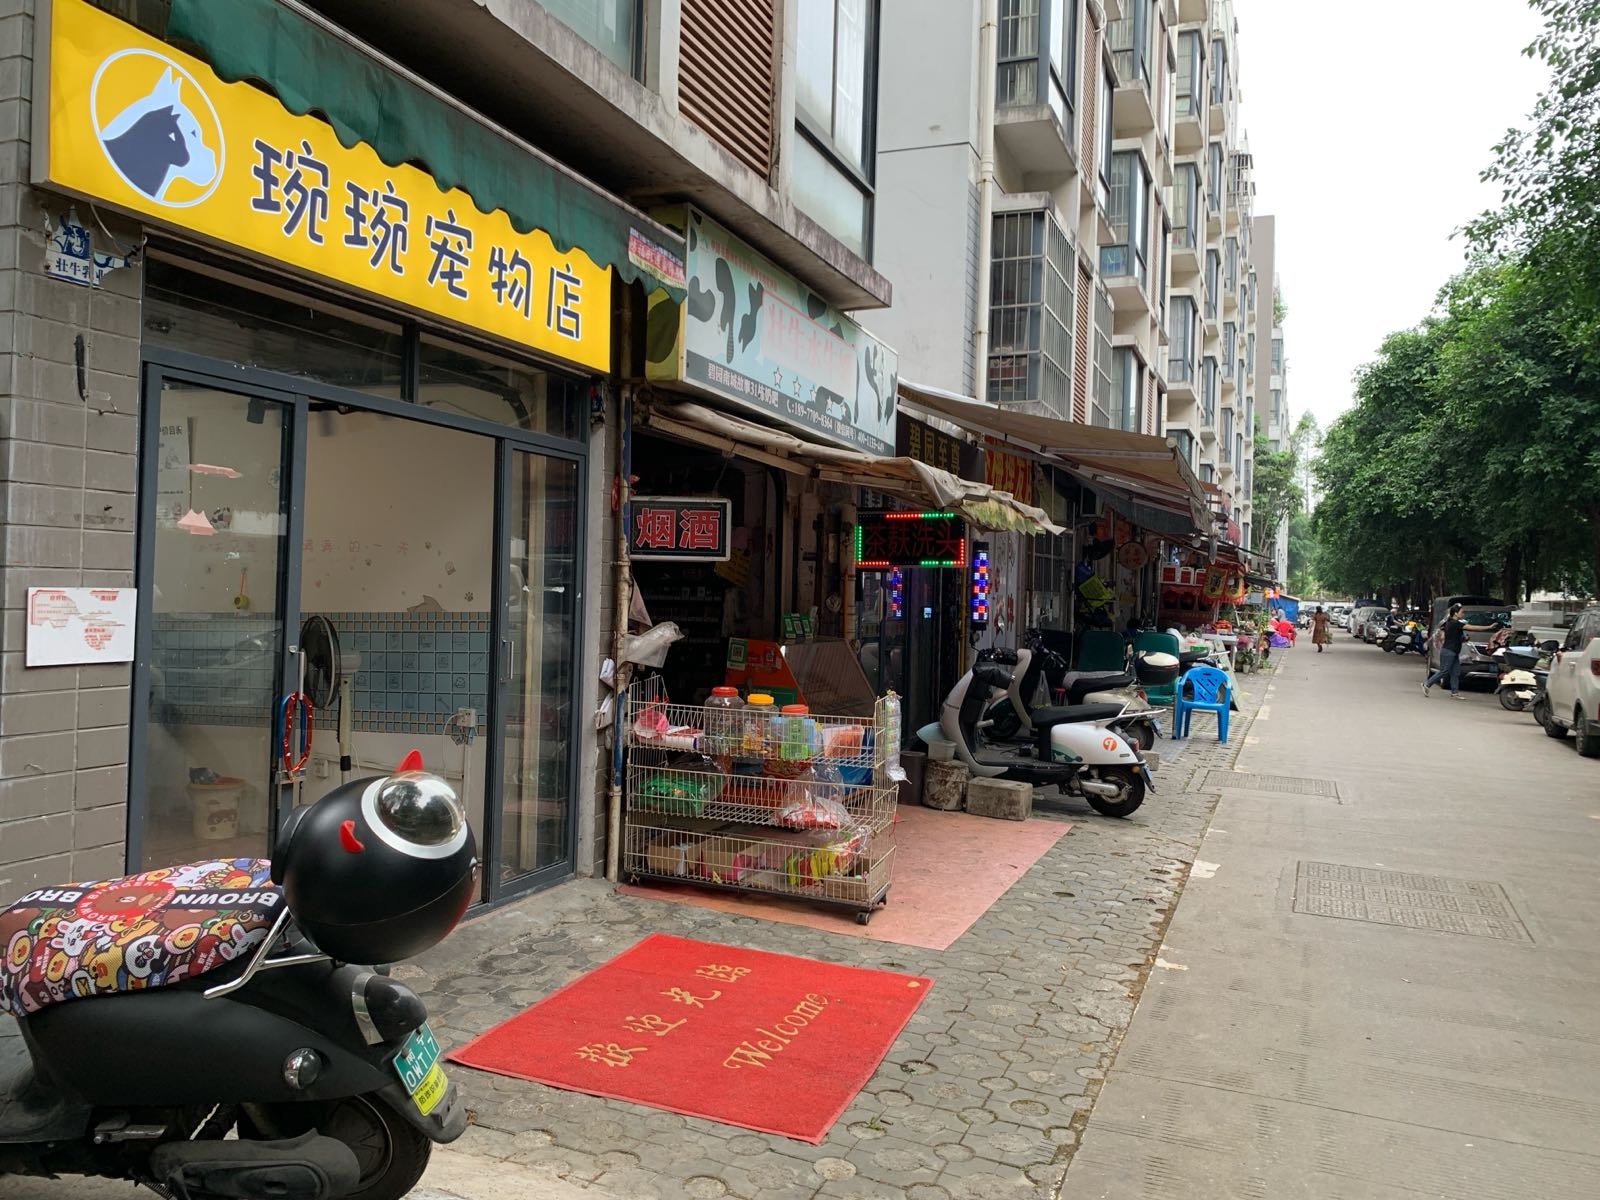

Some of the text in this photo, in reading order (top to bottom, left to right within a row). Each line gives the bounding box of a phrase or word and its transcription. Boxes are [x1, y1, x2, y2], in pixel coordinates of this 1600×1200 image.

[250, 138, 582, 341] 琬琬宠物店
[159, 425, 183, 437] 价目表
[636, 507, 721, 550] 烟酒
[865, 520, 959, 558] 茶麸洗头
[18, 889, 83, 904] BRO
[170, 891, 281, 908] BROWN
[722, 991, 830, 1070] Welcome
